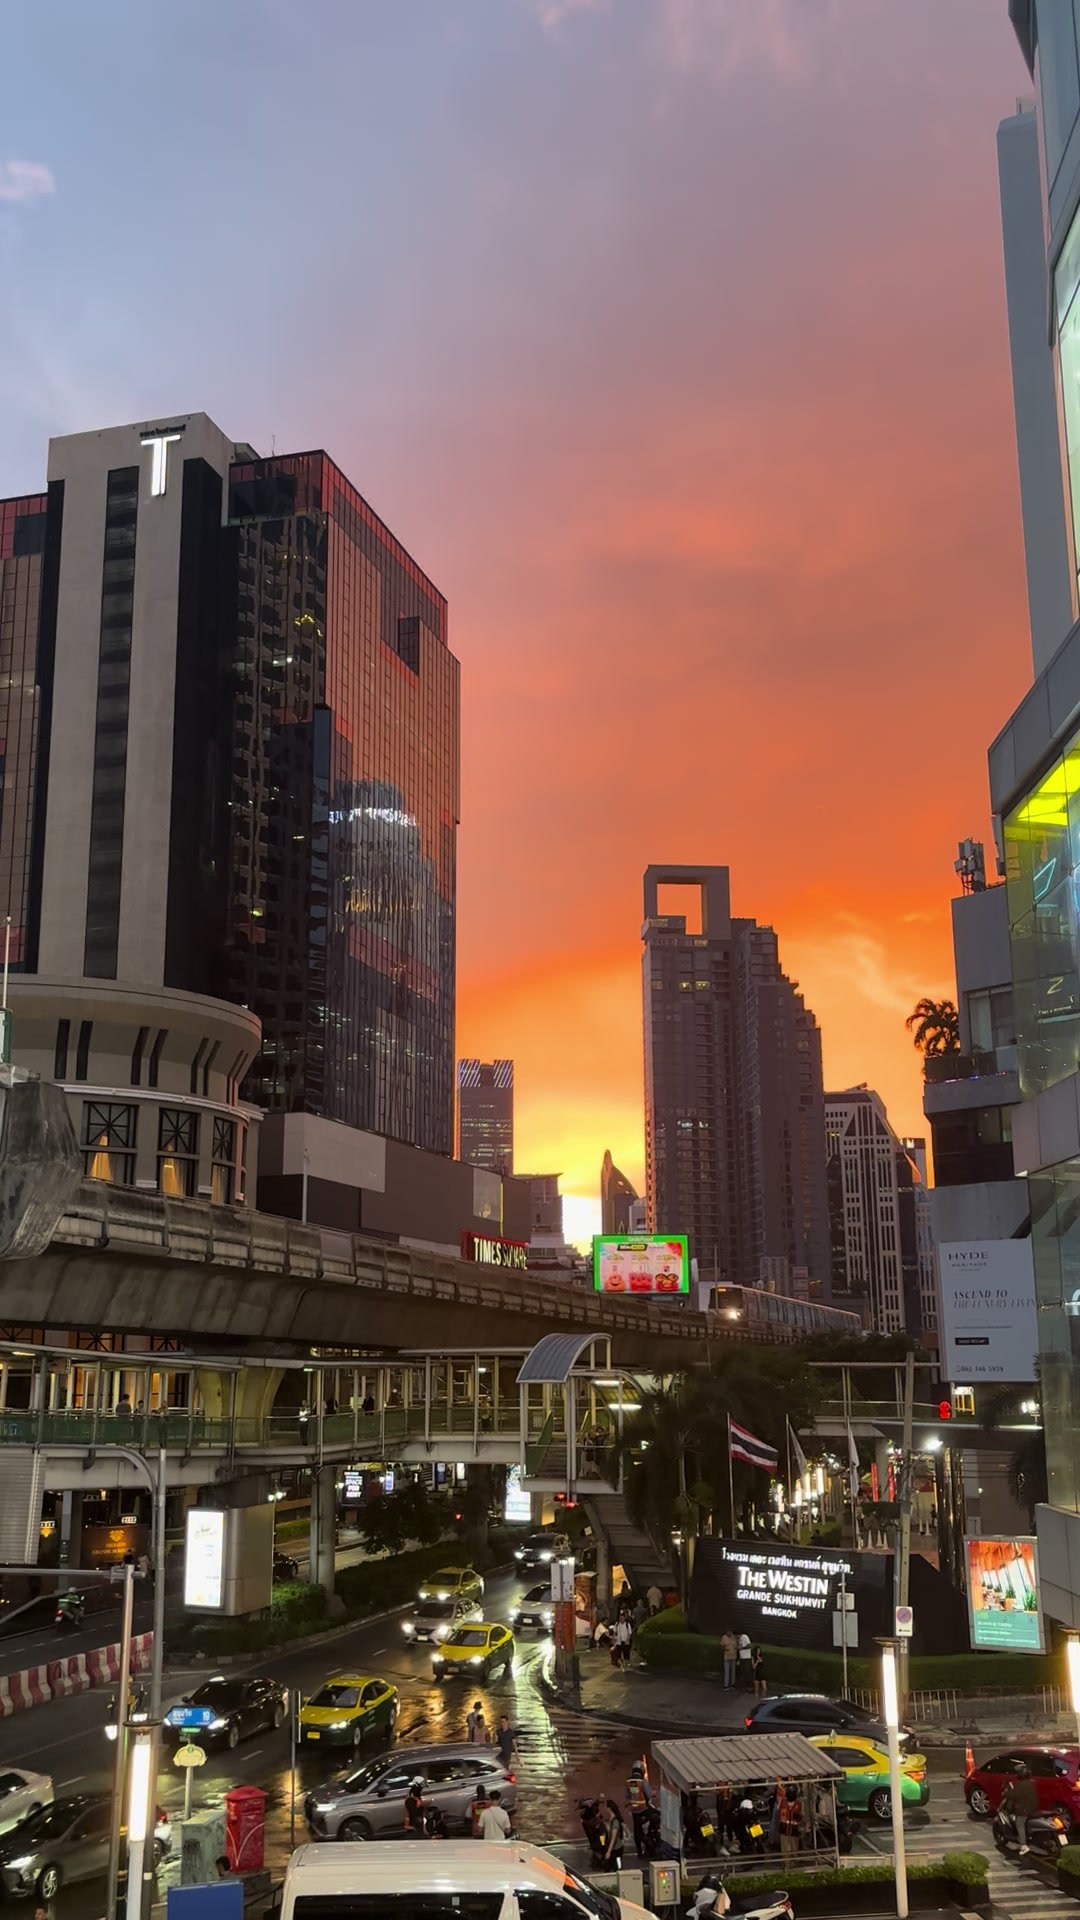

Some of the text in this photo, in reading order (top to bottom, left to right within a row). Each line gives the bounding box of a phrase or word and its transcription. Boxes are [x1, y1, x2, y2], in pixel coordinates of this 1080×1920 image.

[473, 1237, 528, 1270] TIMES SQUARE
[948, 1252, 989, 1260] HYDE
[954, 1290, 1008, 1299] ASCEND TO
[737, 1589, 827, 1609] GRANDE SUKHUMVIT
[762, 1606, 797, 1619] BANGKOK
